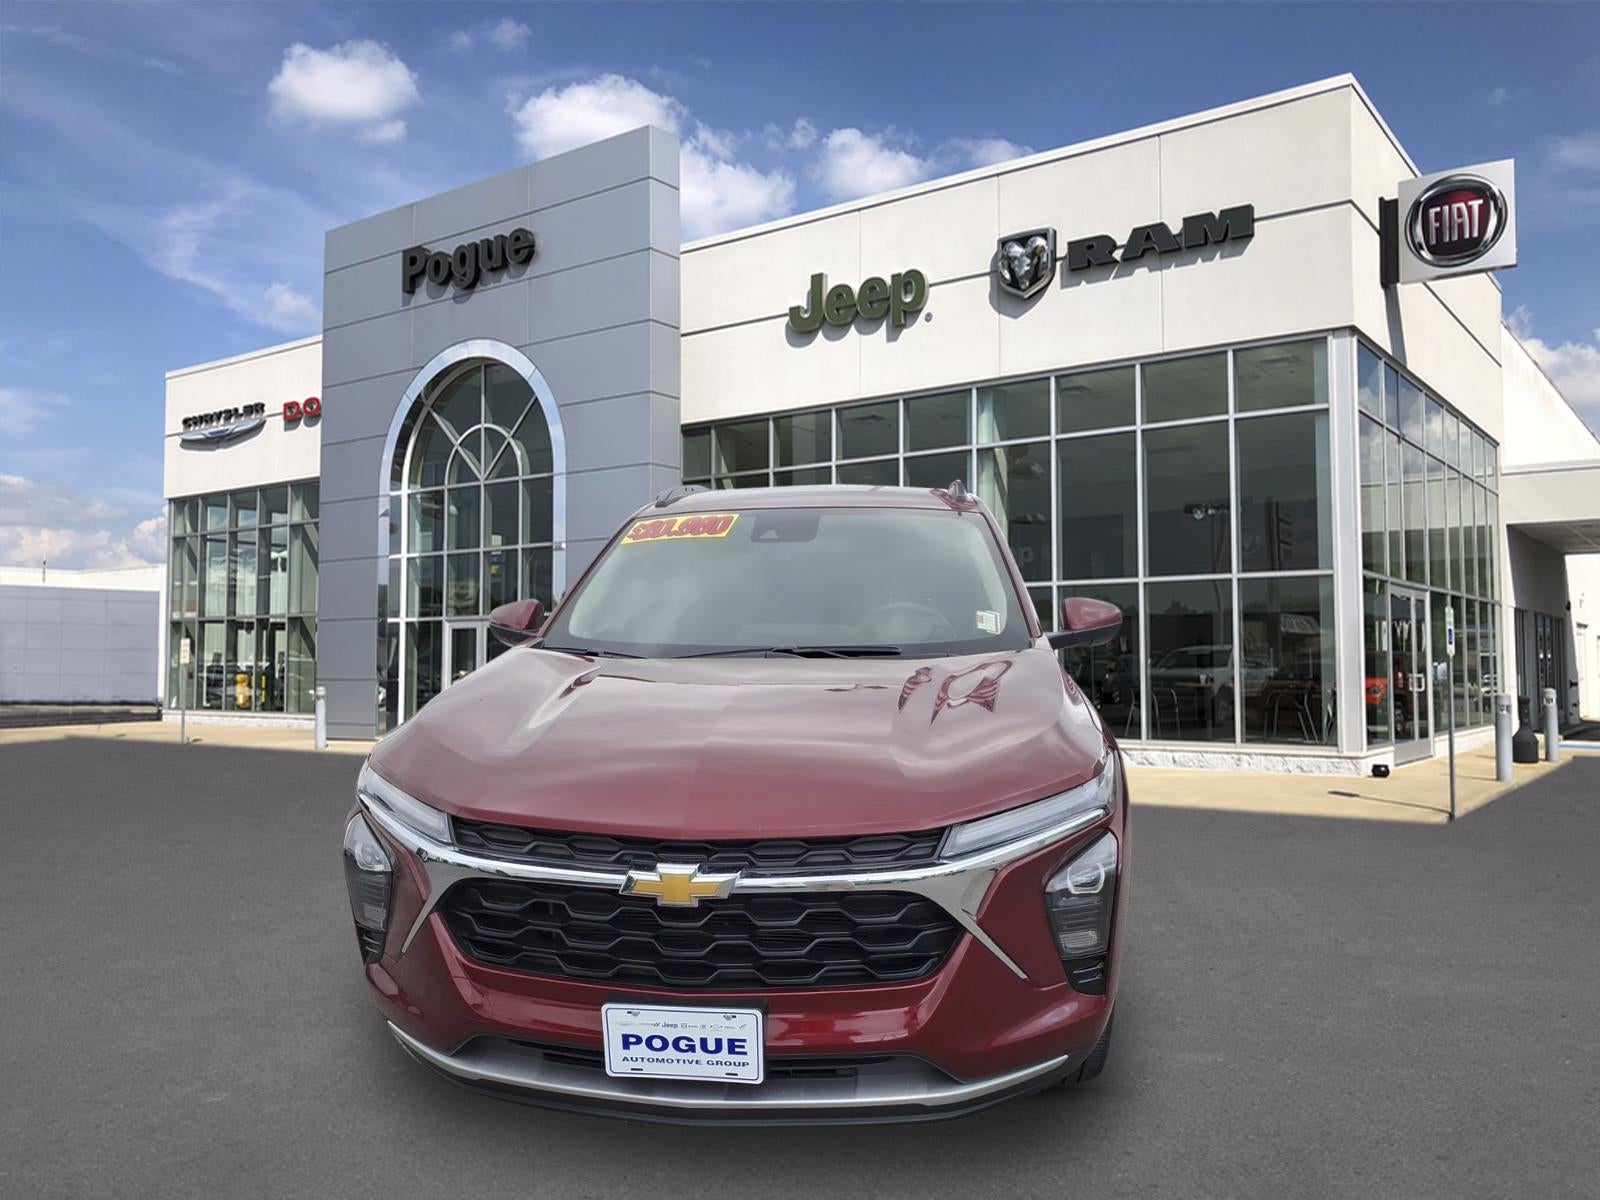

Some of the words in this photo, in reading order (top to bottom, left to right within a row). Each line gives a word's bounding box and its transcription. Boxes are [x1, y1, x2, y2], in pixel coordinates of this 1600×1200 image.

[1067, 204, 1254, 272] RAM
[1428, 199, 1483, 245] FIAT
[402, 227, 535, 294] Pogue
[788, 268, 929, 332] Jeep
[182, 402, 265, 429] CHRYSLER
[621, 1033, 748, 1056] POGUE
[621, 1056, 703, 1066] AUTOMOTIVE
[706, 1059, 750, 1068] GROUP
